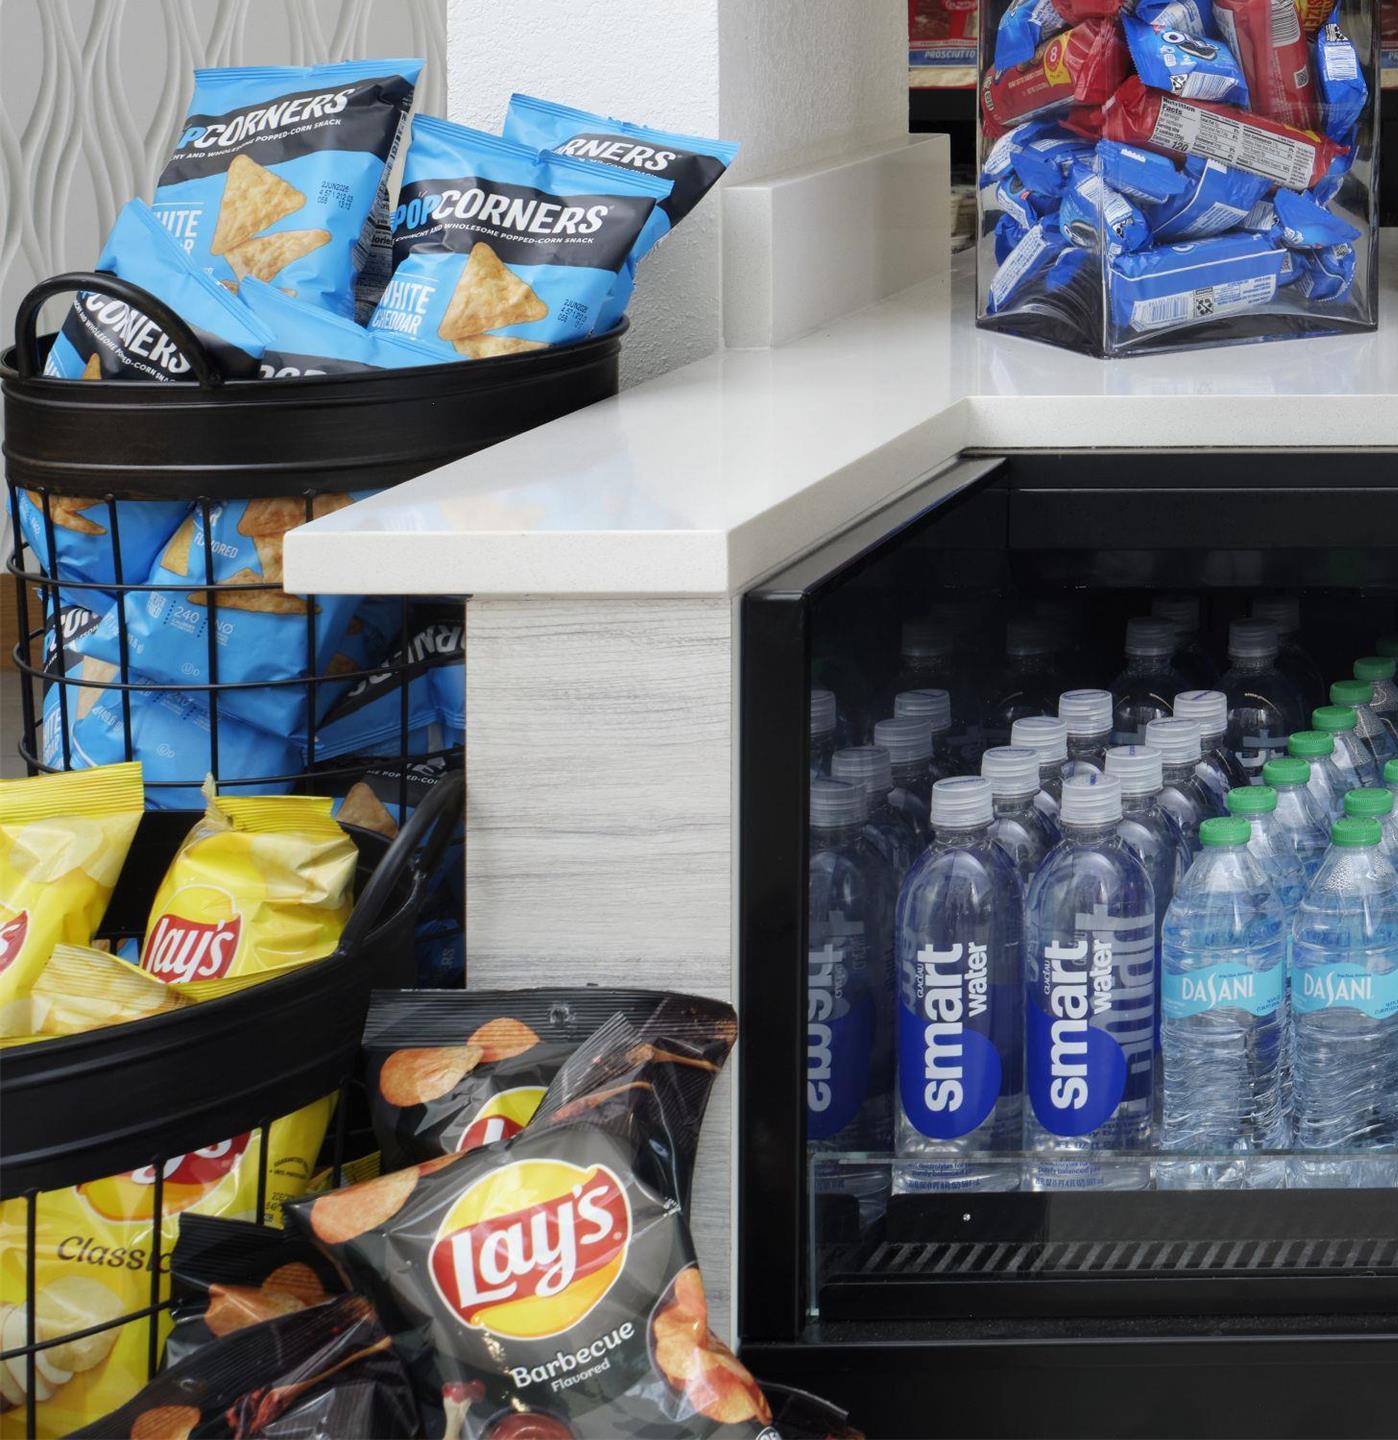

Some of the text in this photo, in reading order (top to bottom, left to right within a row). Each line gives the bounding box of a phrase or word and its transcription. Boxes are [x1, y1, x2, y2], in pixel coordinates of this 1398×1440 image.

[924, 50, 976, 60] PROSCIUTTO
[254, 118, 343, 143] POPPED-CORN SNACK
[390, 187, 610, 236] POPCORNERS
[444, 222, 594, 246] WHOLESOME POPPED-CORN SNACK
[144, 916, 239, 985] Lay's
[964, 940, 988, 1018] water
[1092, 938, 1113, 1015] water
[1180, 970, 1256, 1012] DASANI
[1302, 968, 1374, 1010] DASANI
[916, 942, 966, 1114] smart
[1043, 938, 1090, 1112] smart
[449, 1182, 617, 1311] Lay's
[508, 1320, 638, 1391] Barbecue
[549, 1357, 614, 1395] Flavored
